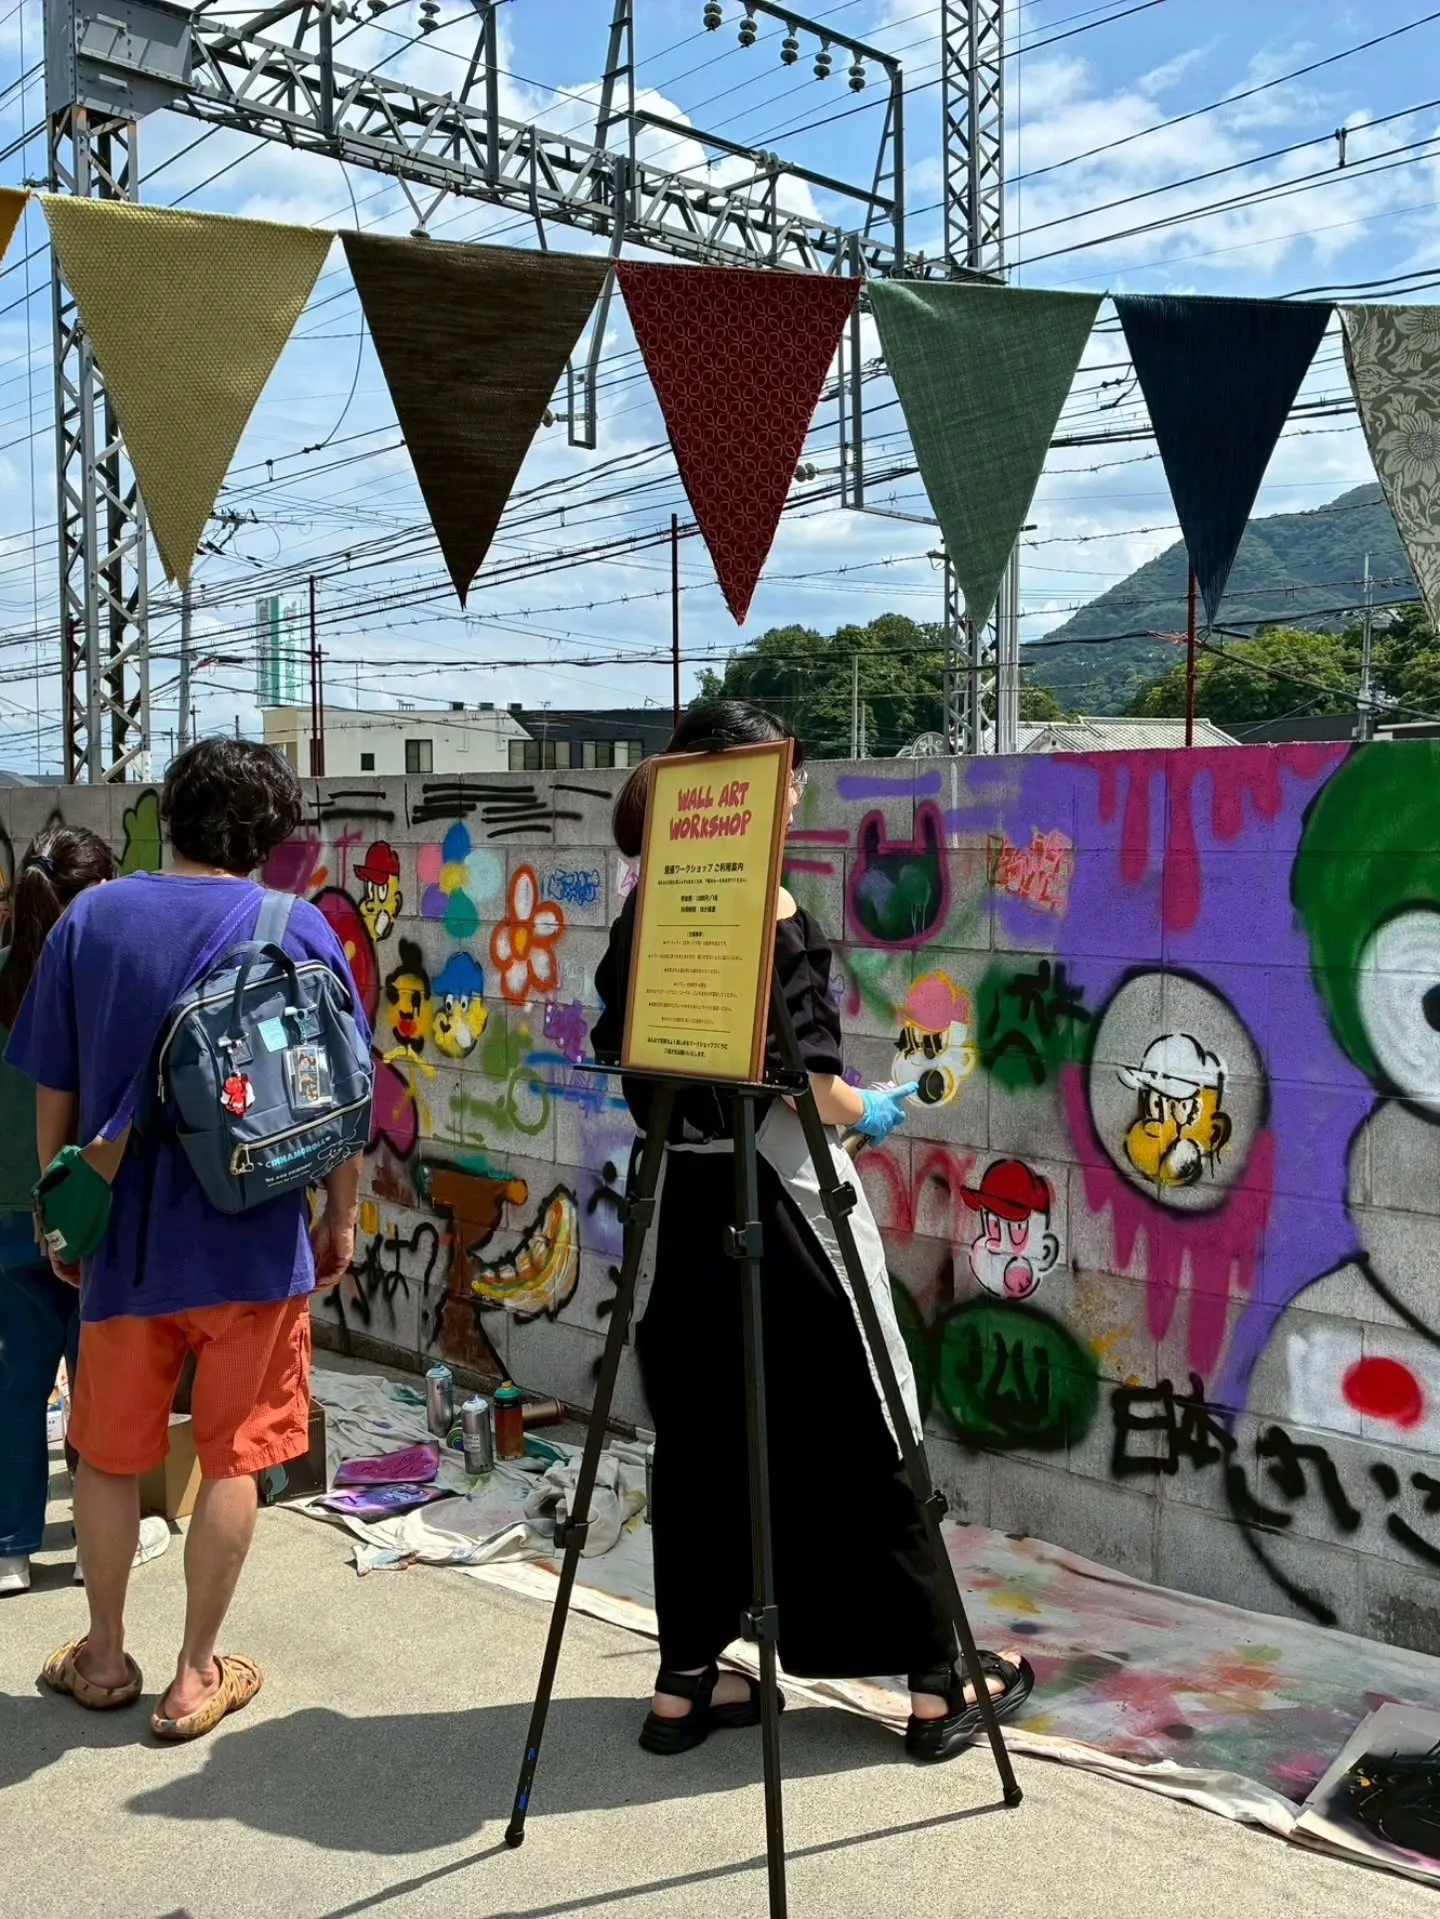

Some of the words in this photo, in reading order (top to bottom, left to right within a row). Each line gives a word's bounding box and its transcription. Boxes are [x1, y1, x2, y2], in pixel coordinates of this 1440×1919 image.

[677, 785, 714, 812] WALL
[718, 780, 750, 807] ART
[669, 809, 752, 841] WORKSHOP
